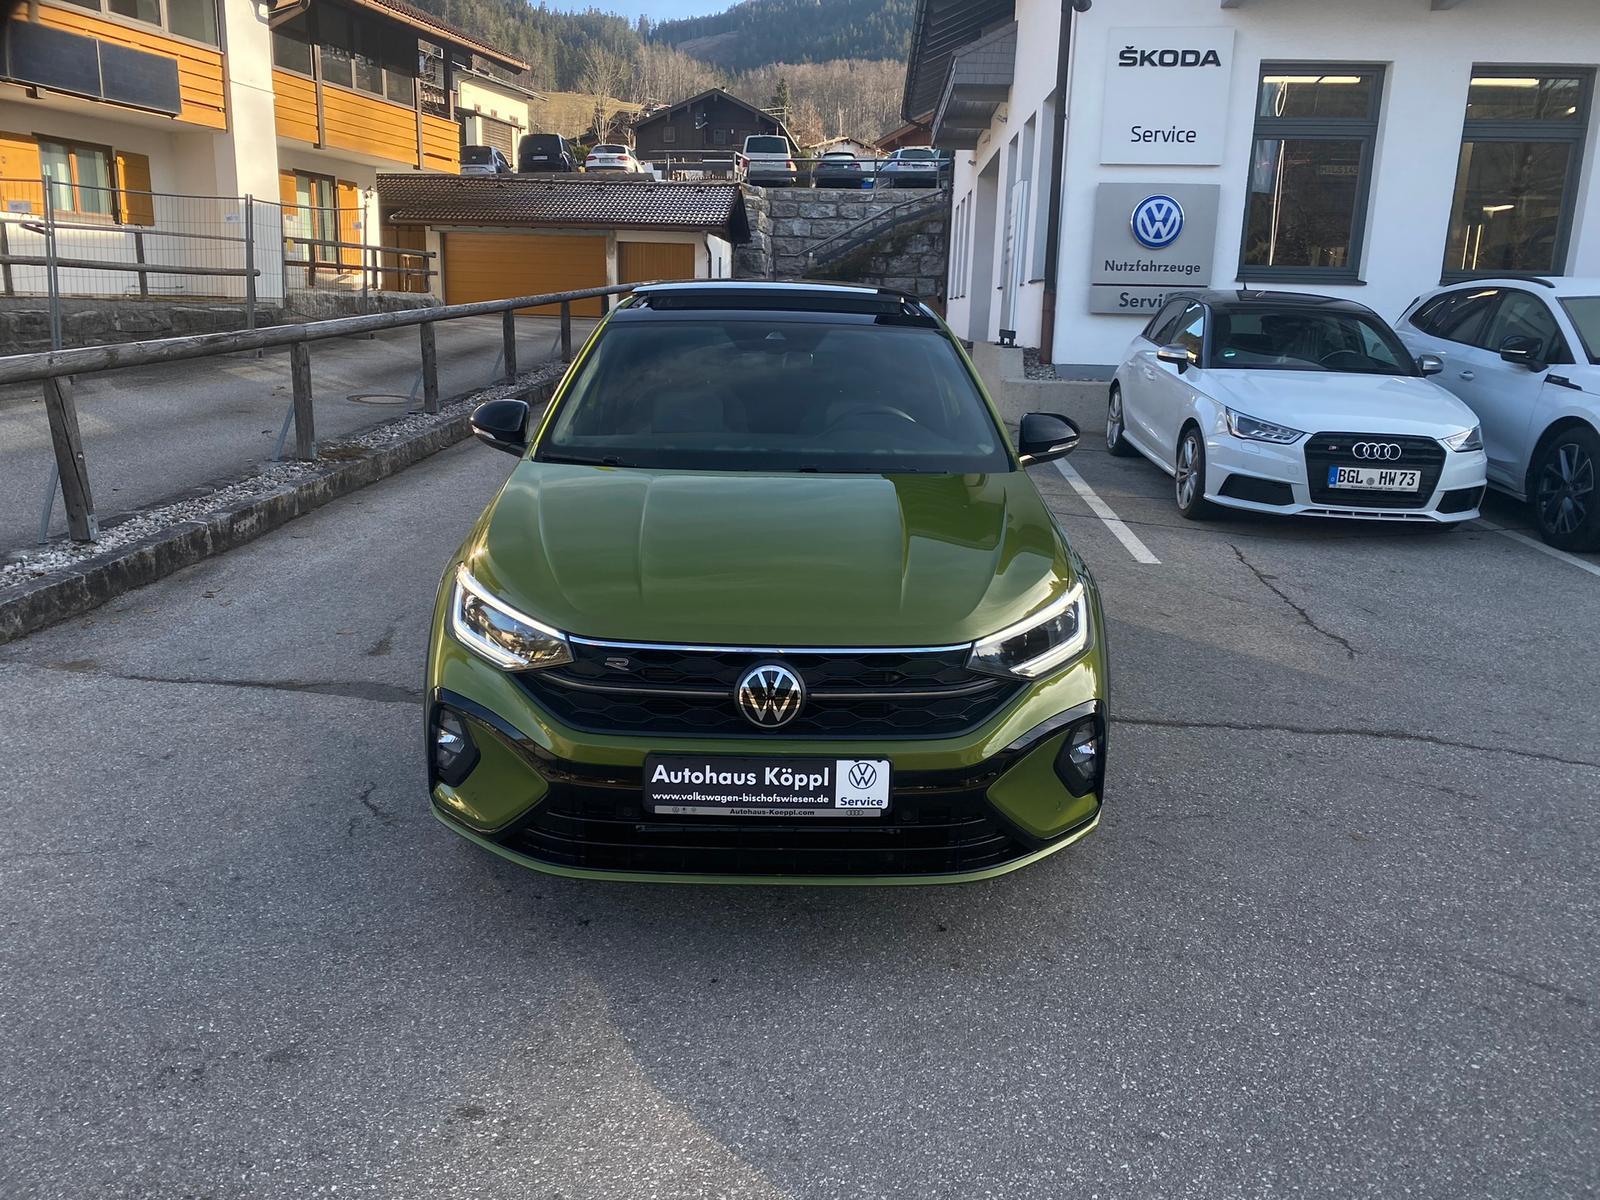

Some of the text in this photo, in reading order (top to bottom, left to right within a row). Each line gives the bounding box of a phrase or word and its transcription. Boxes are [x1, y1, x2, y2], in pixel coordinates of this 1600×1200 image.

[1118, 45, 1222, 67] ŠKODA
[1131, 125, 1197, 143] Service
[1104, 260, 1201, 275] Nutzfahrzeuge
[1119, 291, 1163, 308] Servi
[1338, 469, 1416, 486] BGL HW 73
[651, 764, 829, 790] Autohaus Köppl
[652, 791, 829, 804] www.volkswagen-bischofswiesen.de
[840, 796, 884, 807] Service
[729, 808, 815, 817] Autohaus-Koeppl.com
